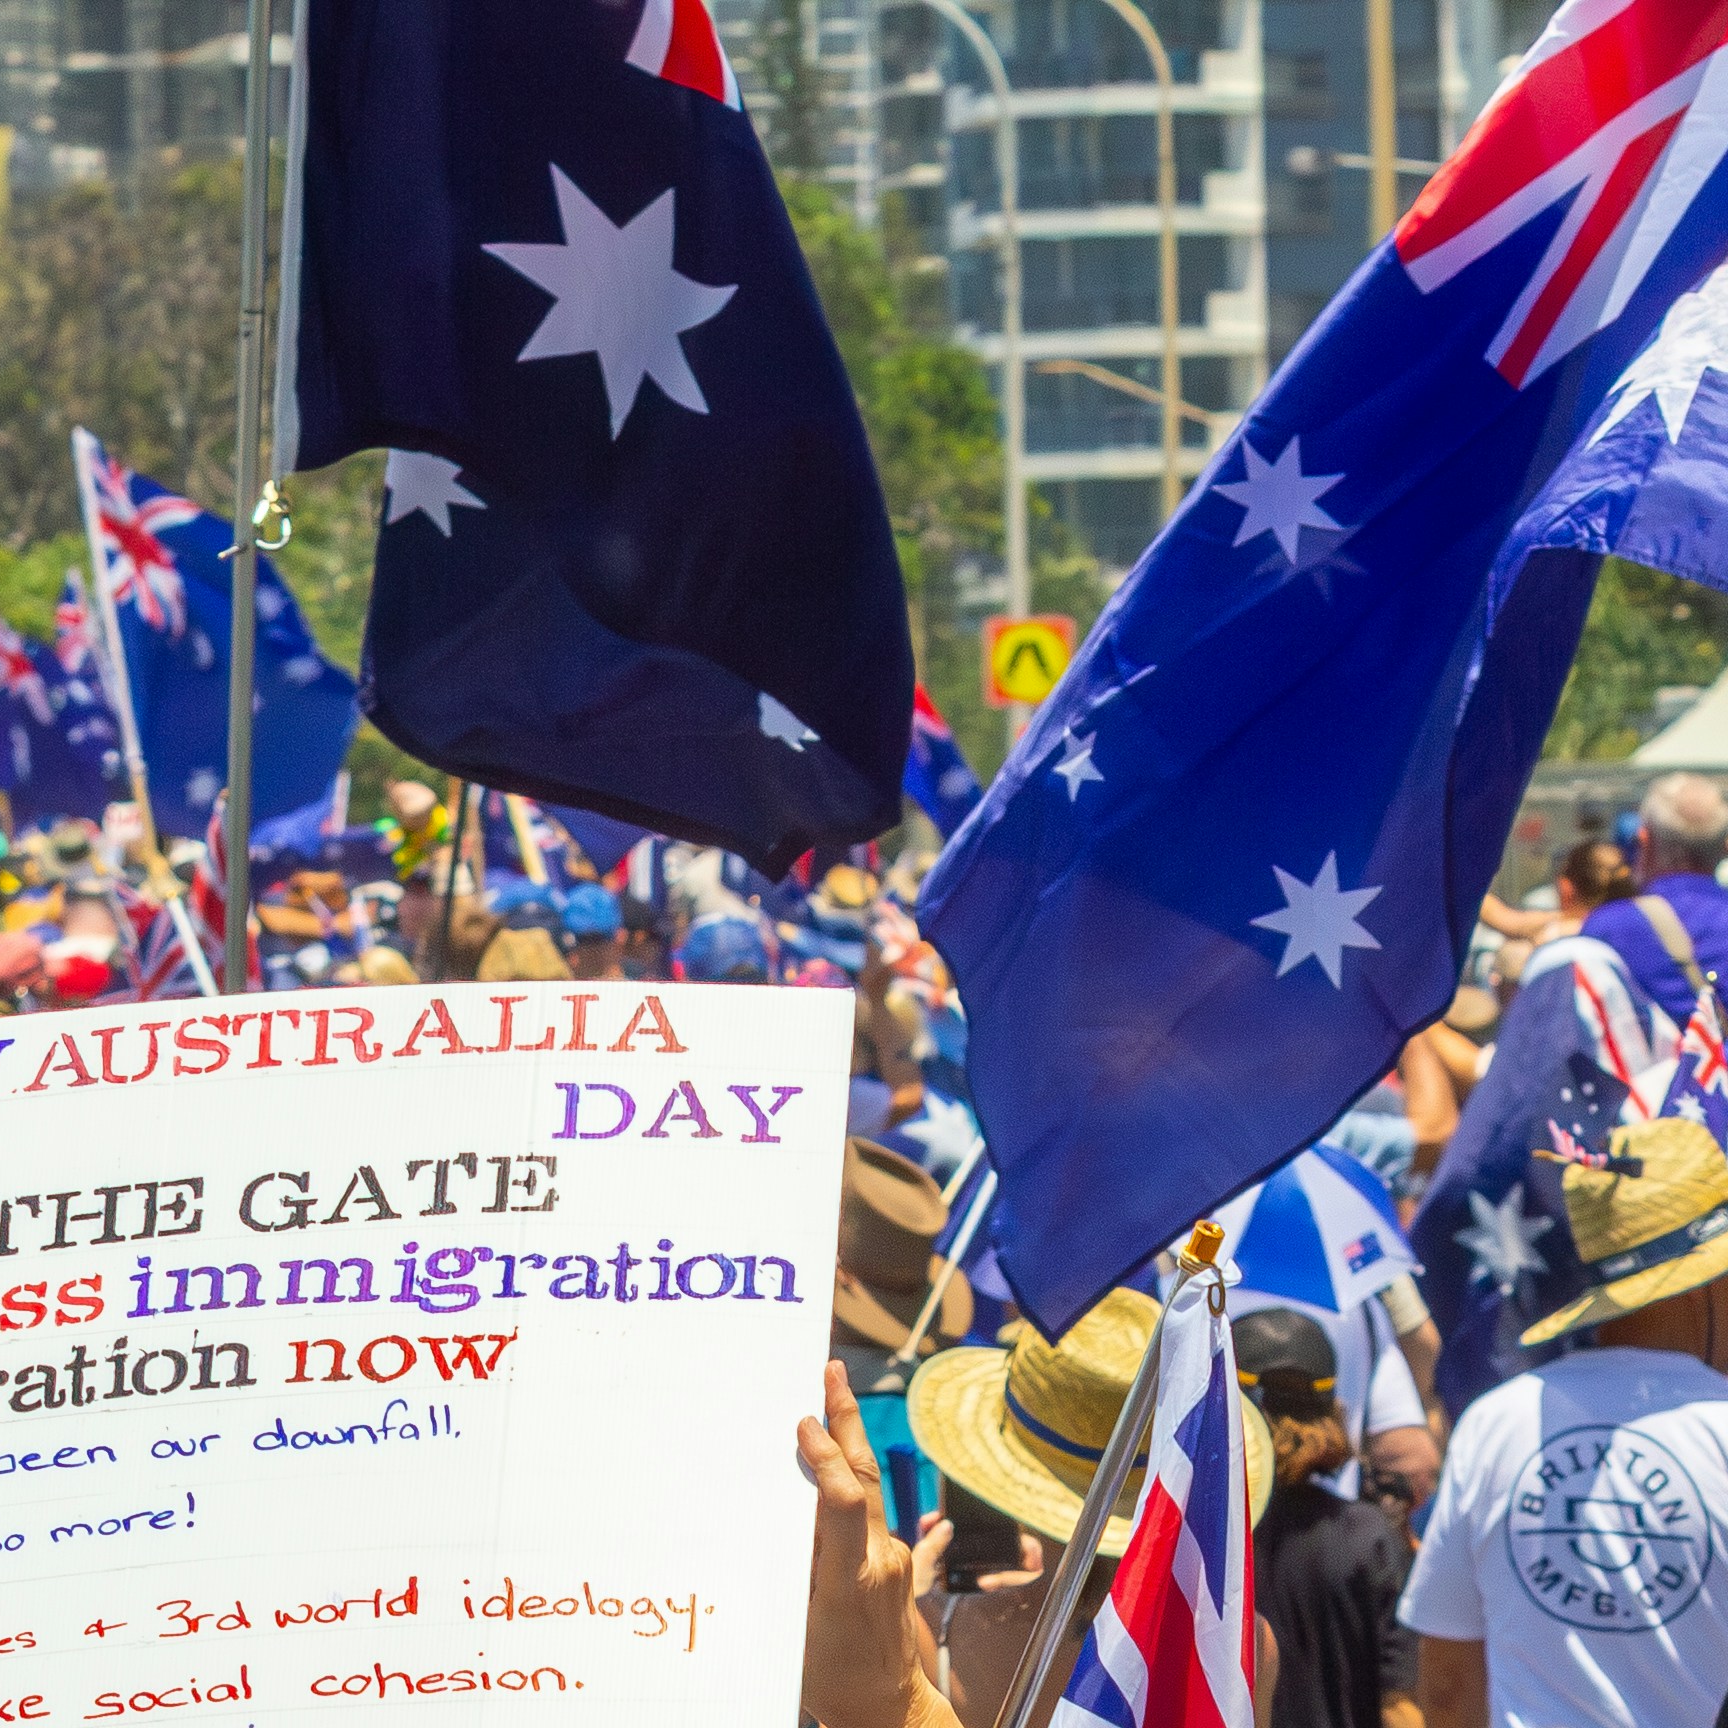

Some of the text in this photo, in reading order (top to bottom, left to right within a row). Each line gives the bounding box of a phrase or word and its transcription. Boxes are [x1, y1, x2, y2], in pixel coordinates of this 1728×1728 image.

[24, 994, 687, 1091] AUSTRALIA
[553, 1081, 802, 1142] DAY
[239, 1153, 556, 1232] GATE
[127, 1240, 803, 1318] immigration
[285, 1327, 518, 1383] now
[1521, 1443, 1690, 1523] BRIXTON
[157, 1600, 251, 1637] 3rd
[275, 1576, 418, 1628] world
[84, 1665, 252, 1719] social
